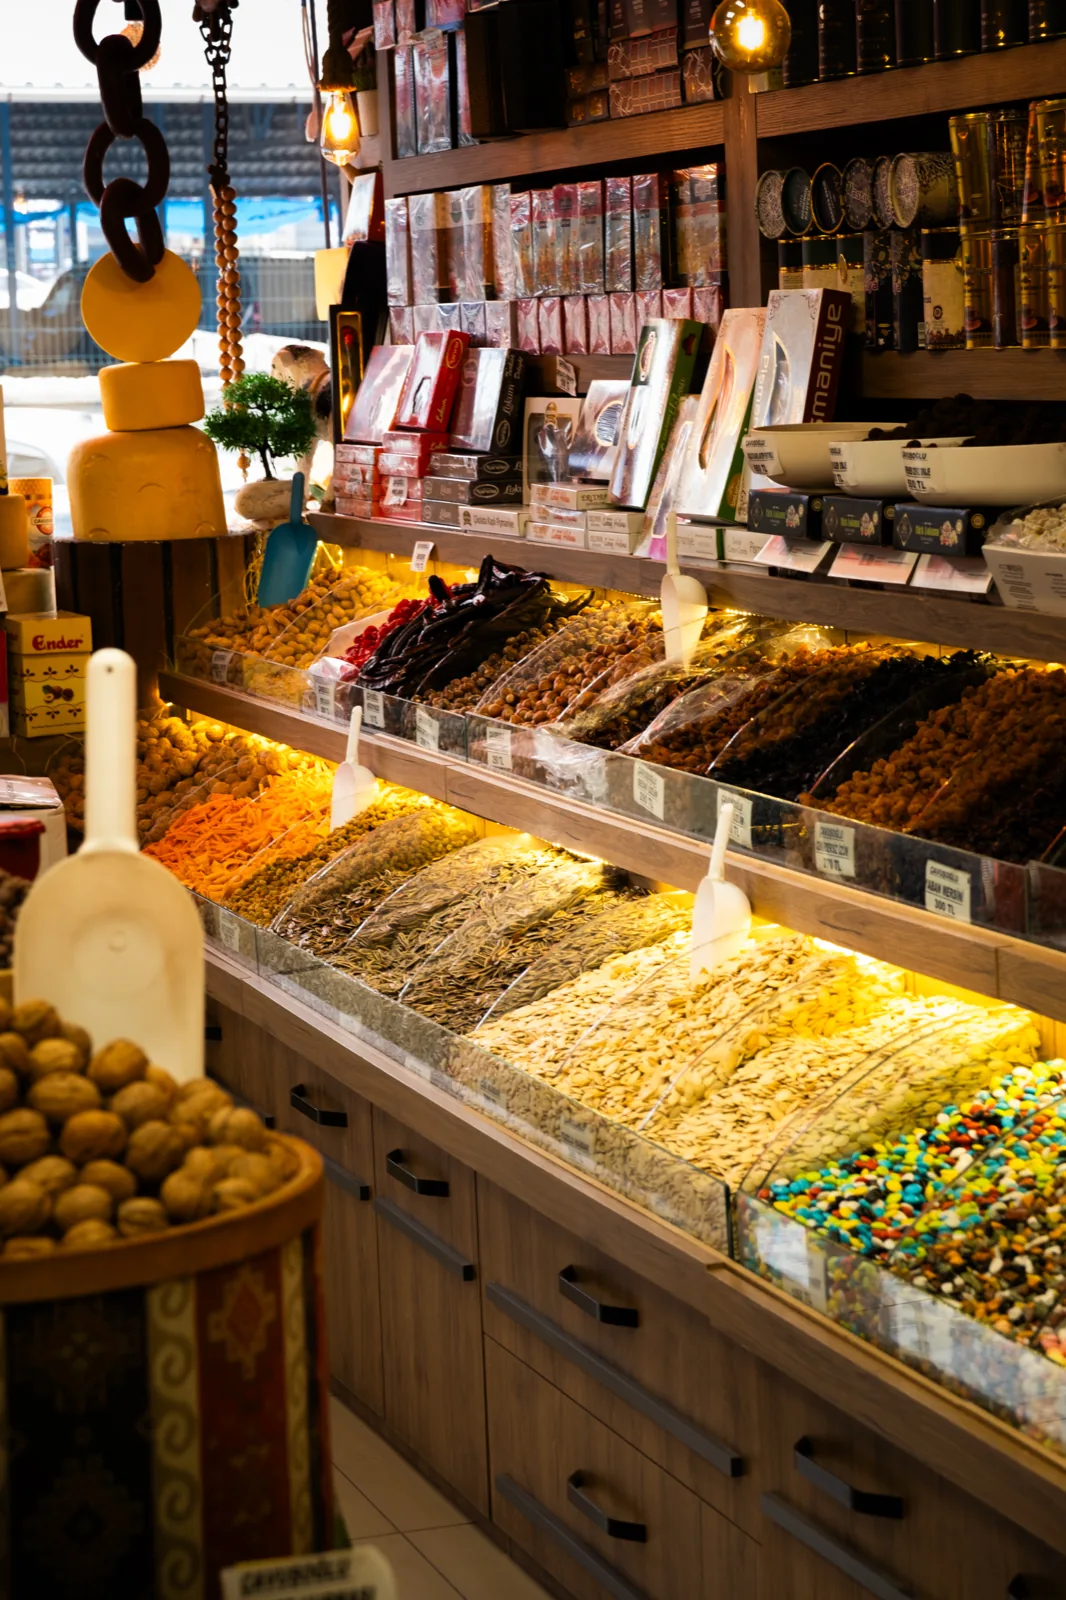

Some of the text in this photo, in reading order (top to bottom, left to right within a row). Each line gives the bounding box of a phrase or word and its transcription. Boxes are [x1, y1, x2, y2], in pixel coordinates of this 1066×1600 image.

[503, 384, 515, 415] Lokum
[32, 634, 84, 651] Ender
[926, 880, 941, 894] ABAN
[947, 903, 956, 915] TL
